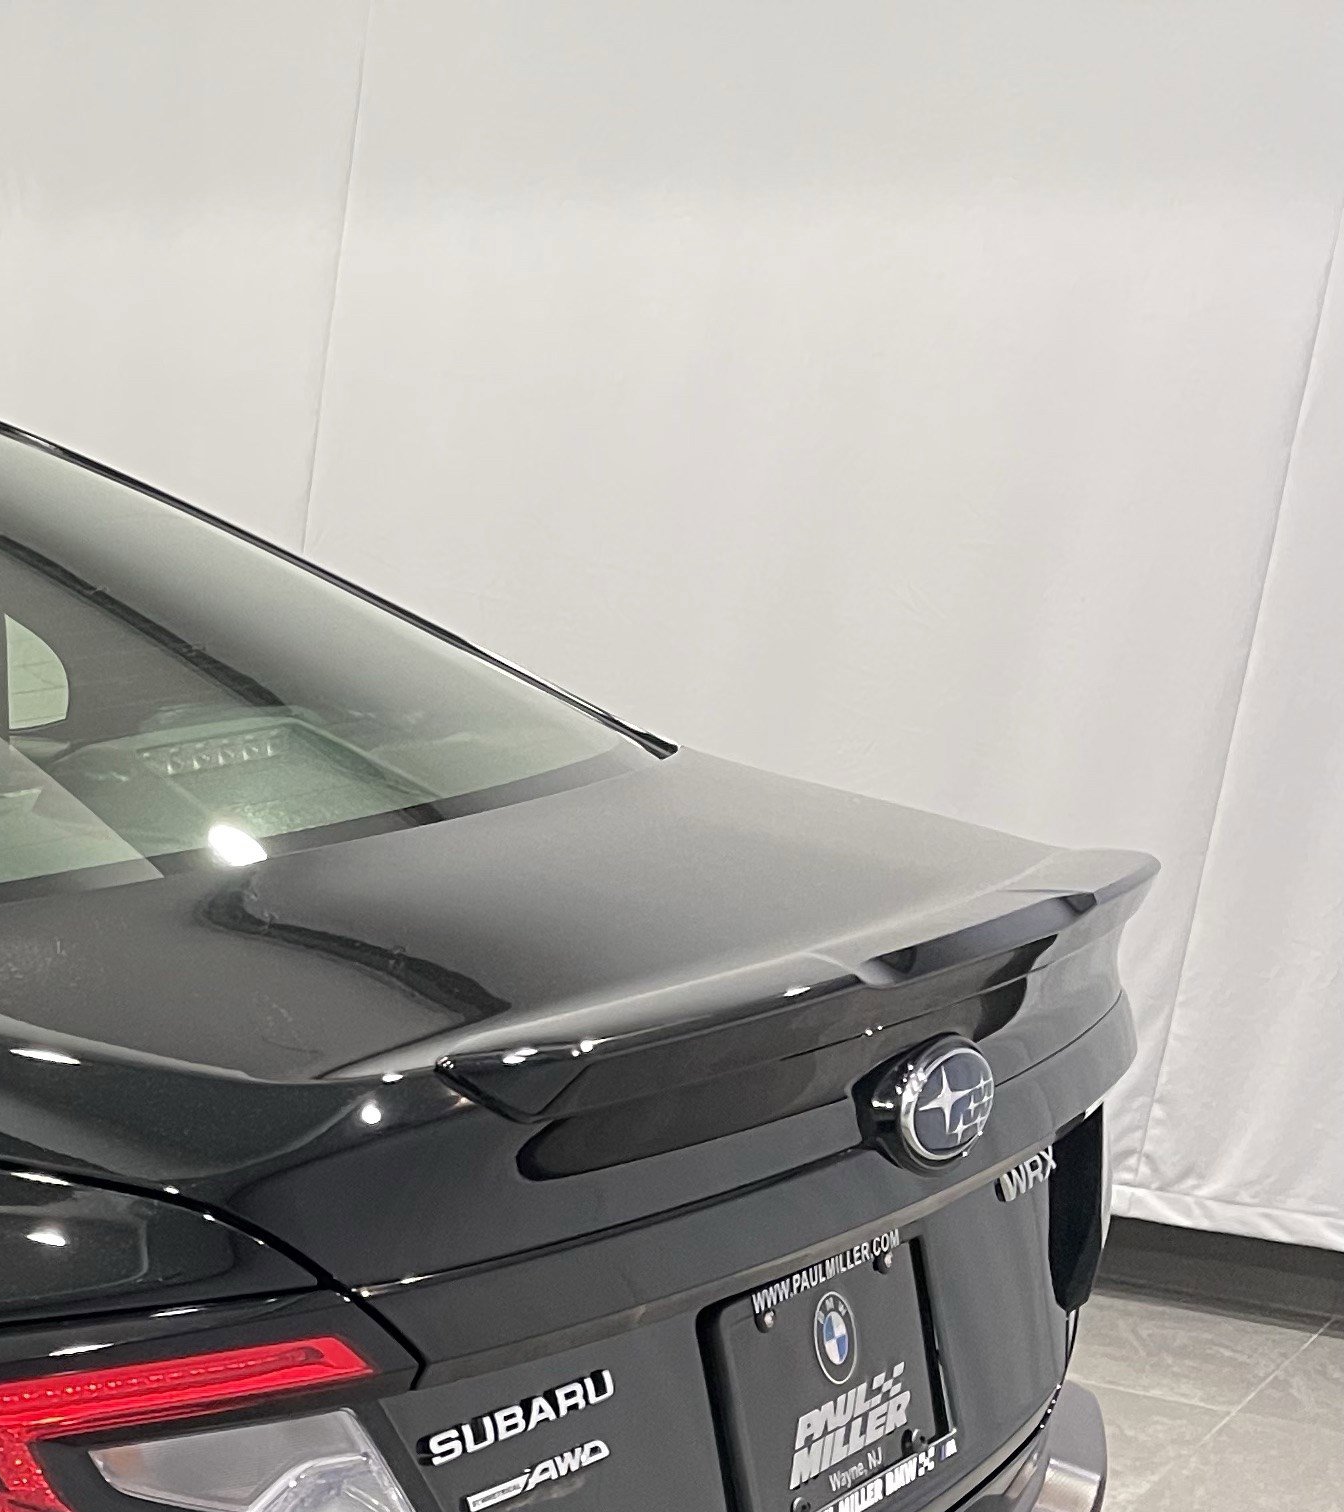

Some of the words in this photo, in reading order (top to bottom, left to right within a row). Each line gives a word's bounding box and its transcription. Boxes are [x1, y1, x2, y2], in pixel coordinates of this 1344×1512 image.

[1000, 1145, 1057, 1202] WRX
[752, 1229, 900, 1314] WWW.PAULMILLER.COM
[429, 1369, 615, 1467] SUBARU
[789, 1391, 911, 1490] MILLER
[794, 1381, 872, 1451] PAUL
[524, 1440, 611, 1492] AWD
[867, 1447, 883, 1470] NJ
